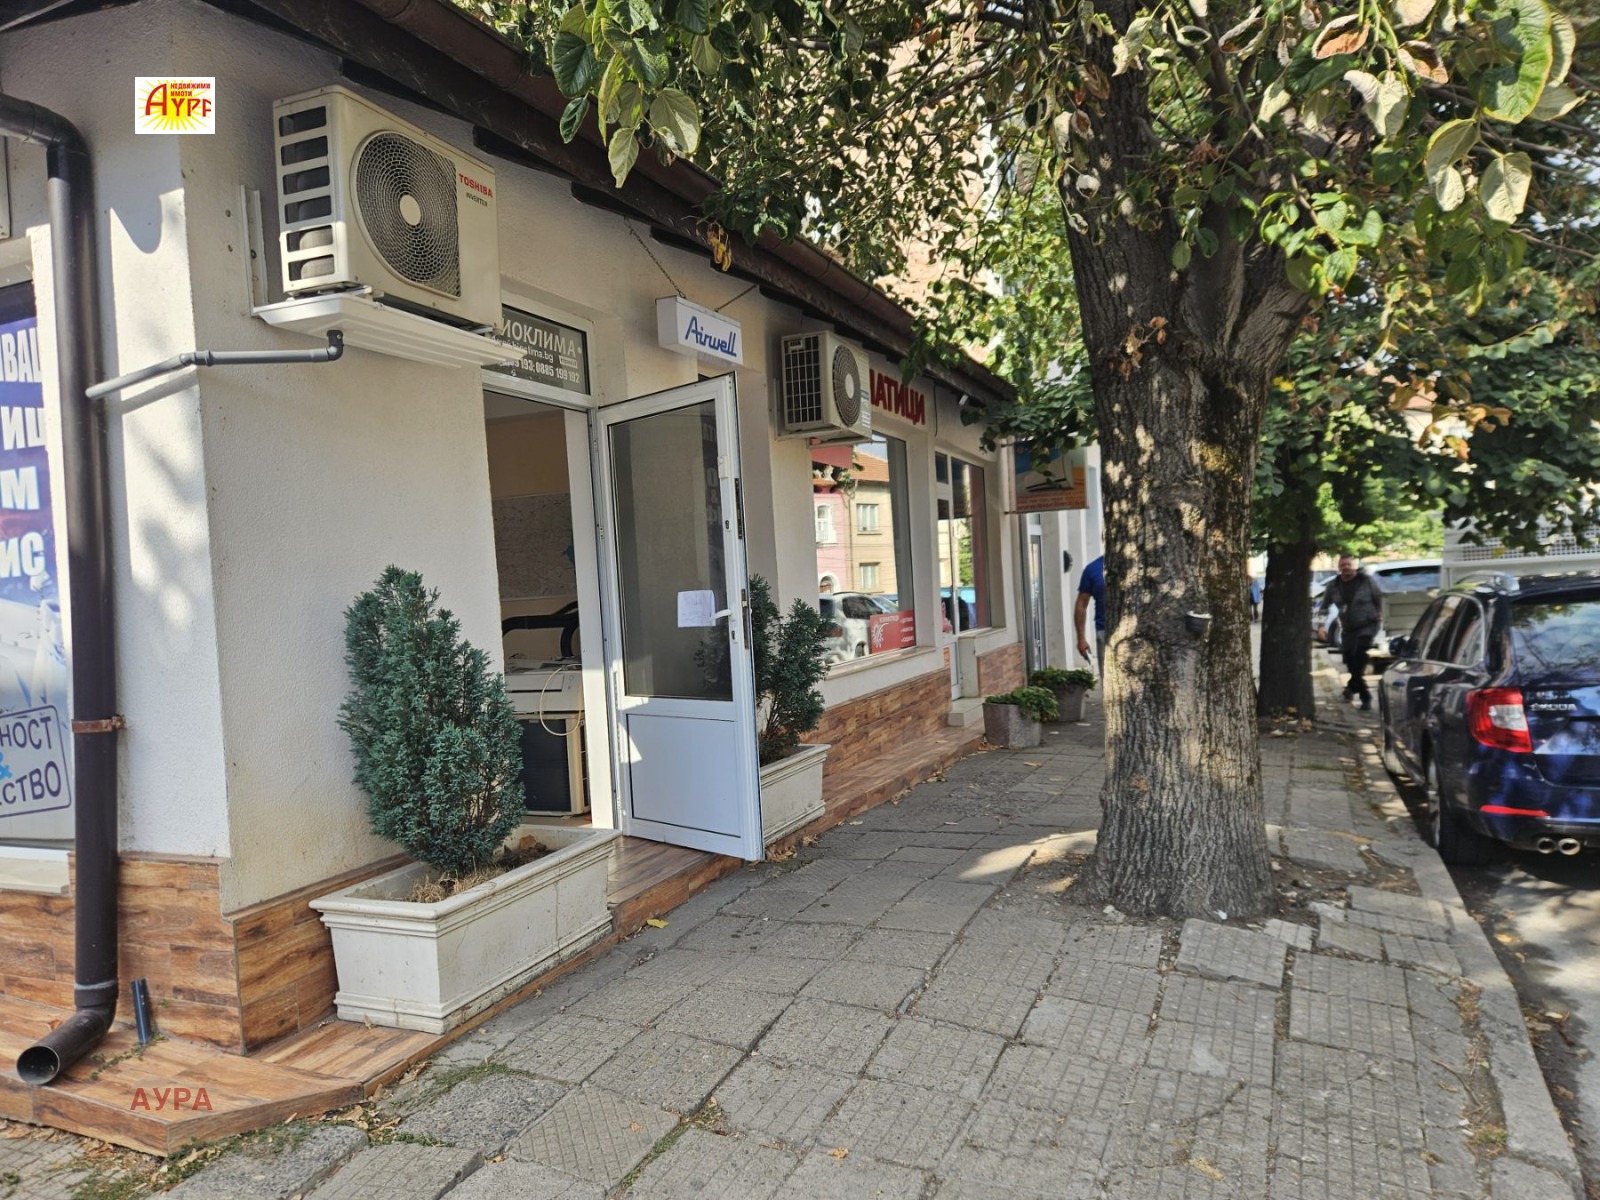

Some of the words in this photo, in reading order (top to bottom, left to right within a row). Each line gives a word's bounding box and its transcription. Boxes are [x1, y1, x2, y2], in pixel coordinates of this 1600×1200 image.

[458, 173, 494, 199] TOSHIBA
[684, 315, 737, 357] Airwell
[0, 760, 61, 806] СТВО
